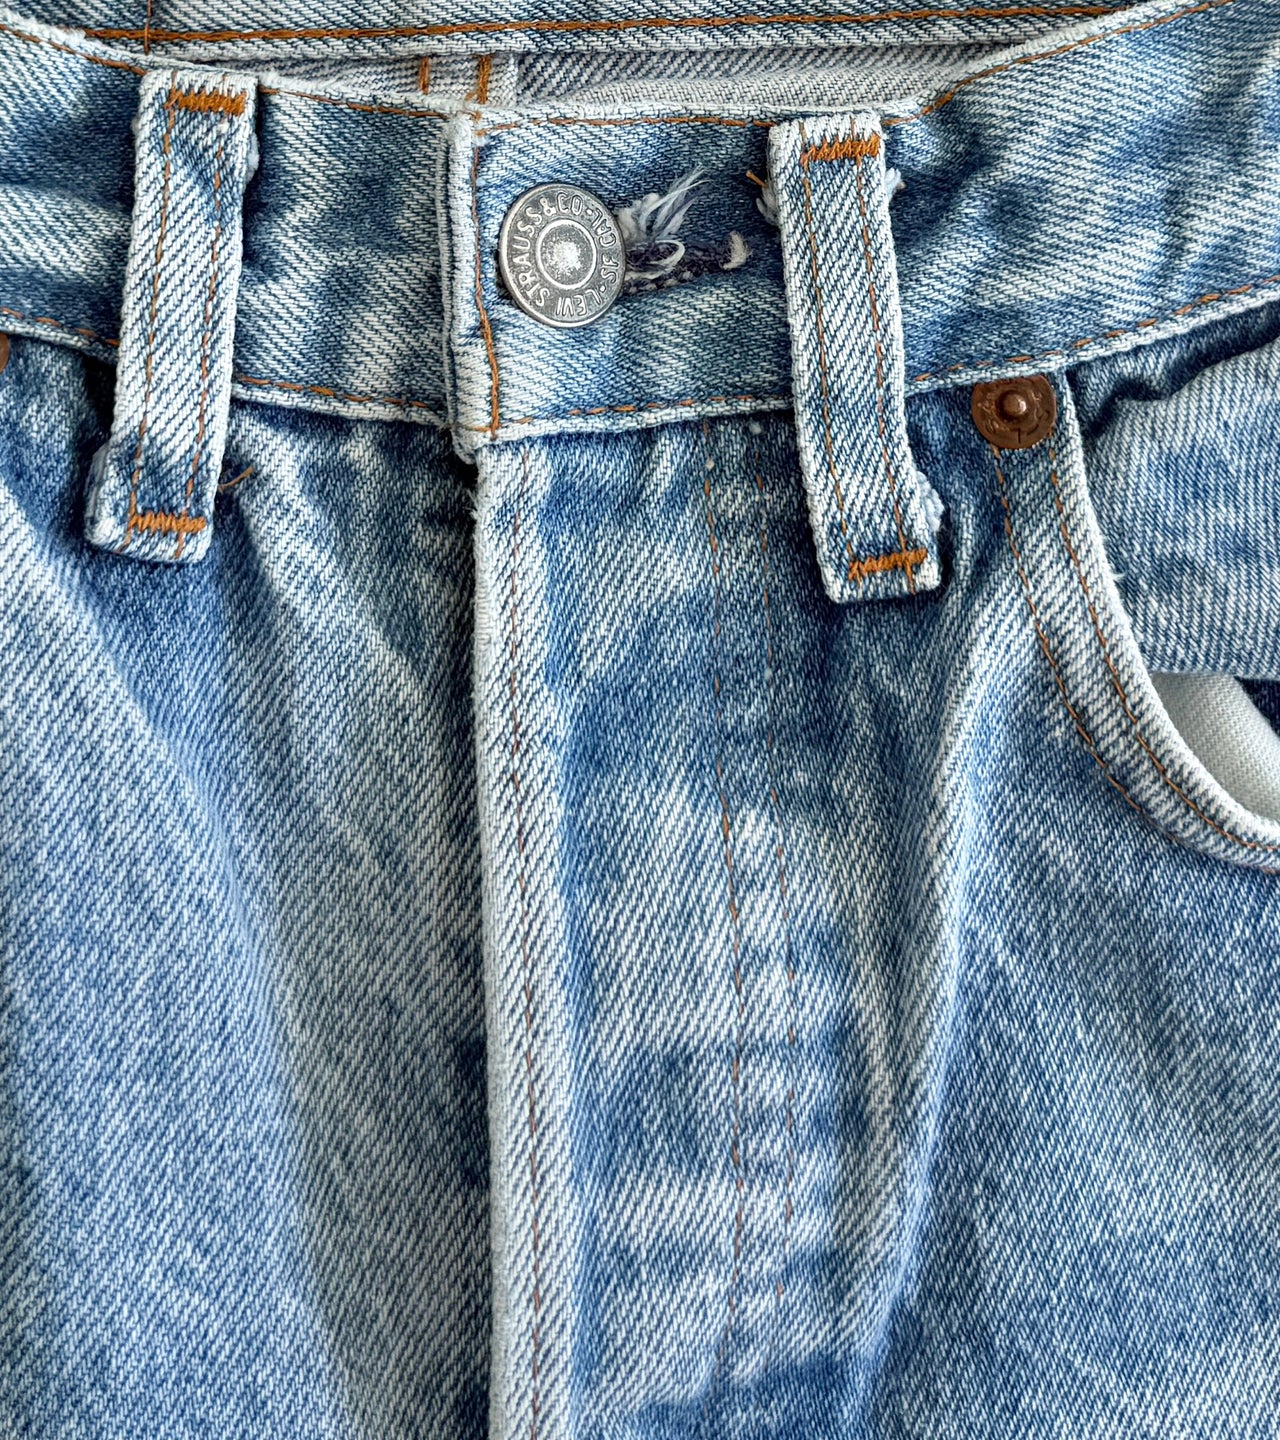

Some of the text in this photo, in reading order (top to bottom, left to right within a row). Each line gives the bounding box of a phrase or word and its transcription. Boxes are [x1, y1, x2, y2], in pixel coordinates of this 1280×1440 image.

[590, 208, 617, 248] CAL
[511, 206, 551, 308] STRAUSS
[555, 288, 602, 317] LEVI
